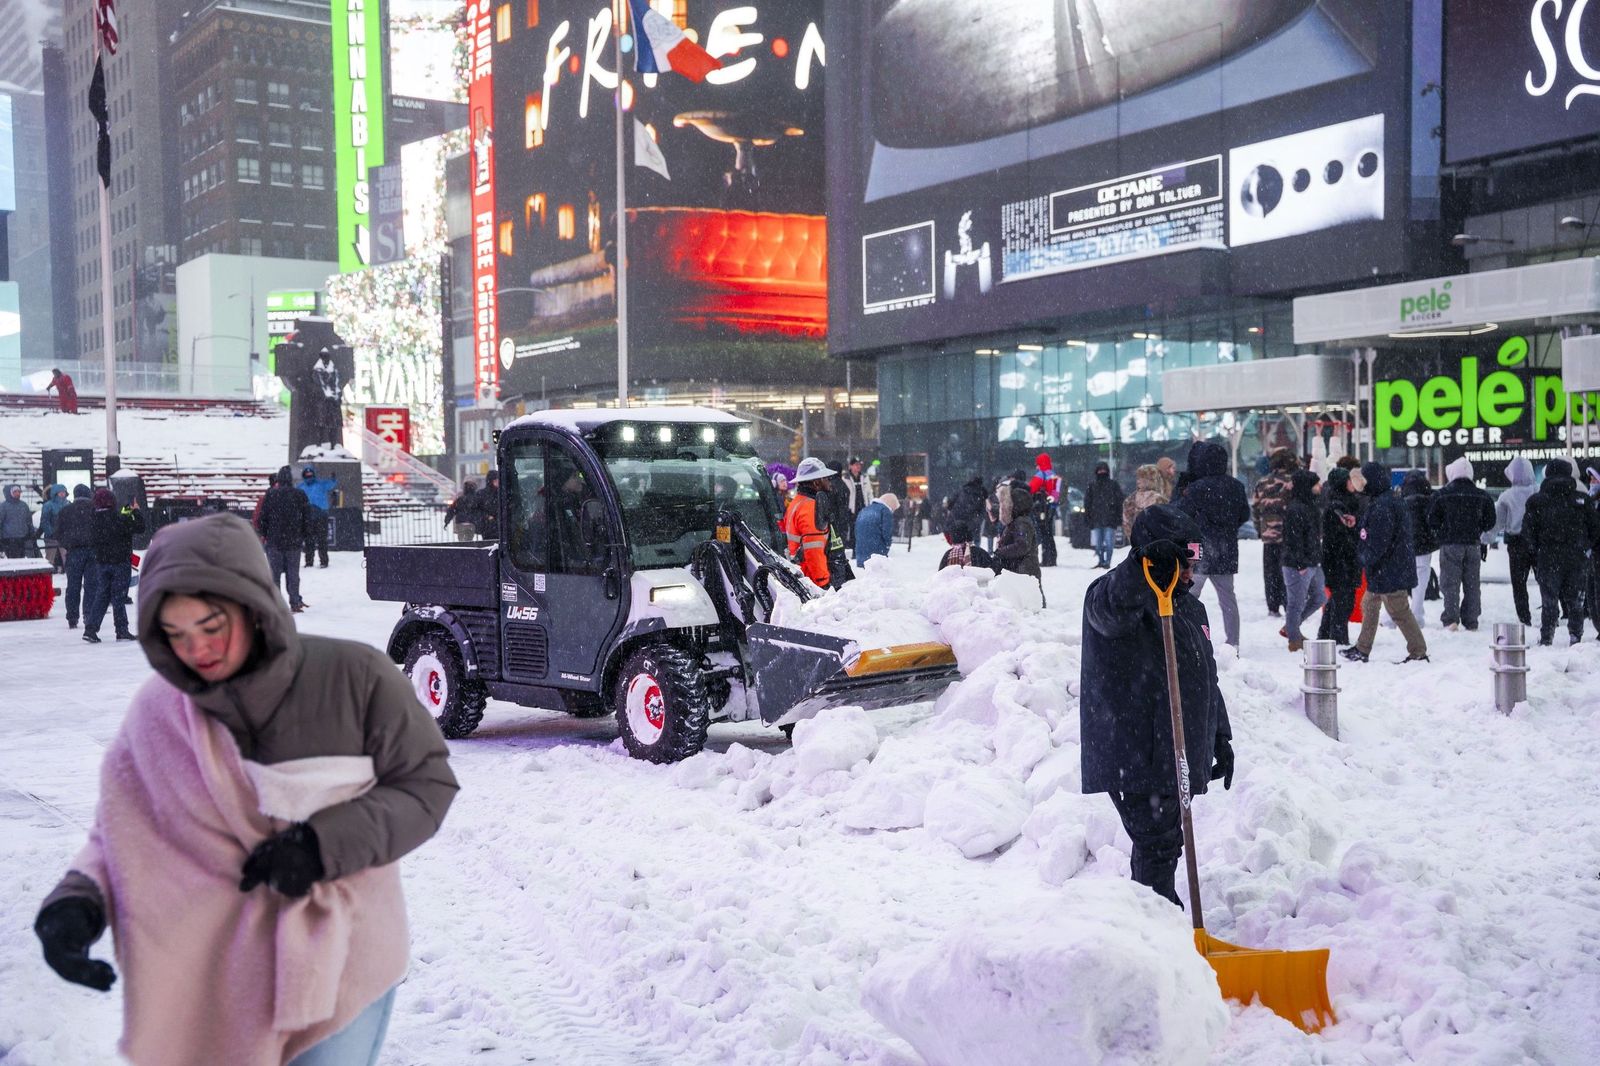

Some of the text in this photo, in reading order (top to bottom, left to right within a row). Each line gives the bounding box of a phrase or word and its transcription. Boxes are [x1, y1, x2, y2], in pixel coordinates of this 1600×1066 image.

[348, 0, 369, 215] NNABIS
[1068, 203, 1116, 223] PRESENTED
[1120, 200, 1132, 213] BY
[1159, 184, 1202, 204] TOLIVER
[1098, 175, 1163, 203] OCTANE
[476, 211, 494, 270] FREE
[1401, 280, 1452, 322] pelé
[1375, 336, 1528, 449] pelé
[1406, 427, 1501, 447] SOCCER
[1464, 451, 1481, 462] THE
[1520, 448, 1568, 460] GREATEST
[507, 606, 539, 620] UW56
[1179, 749, 1190, 793] Garant
